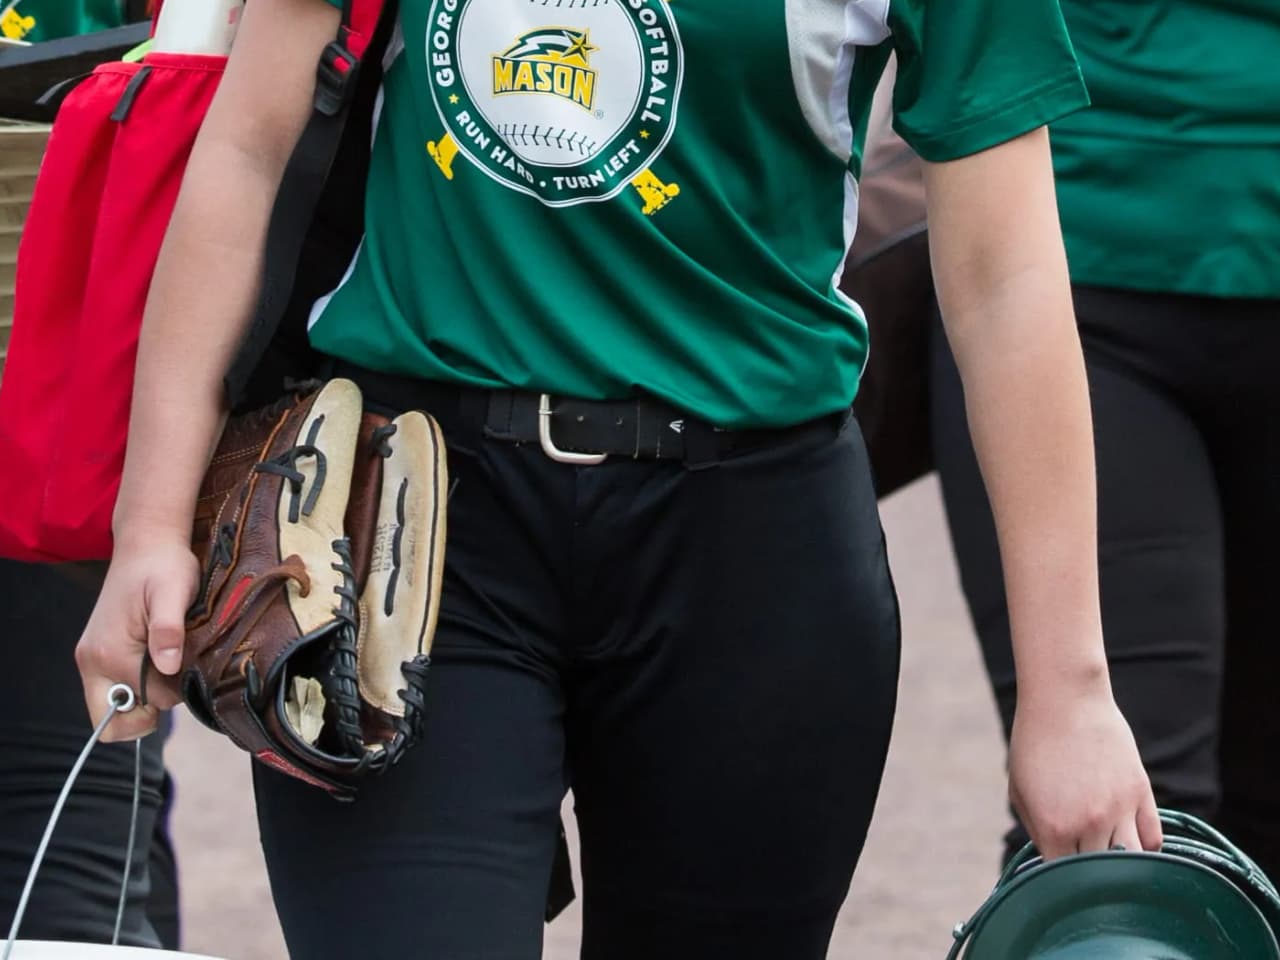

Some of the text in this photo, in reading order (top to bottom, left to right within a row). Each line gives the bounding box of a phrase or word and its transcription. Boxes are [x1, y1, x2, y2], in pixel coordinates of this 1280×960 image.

[492, 55, 597, 112] MASON
[455, 110, 642, 191] RUN HARD TURN LEFT
